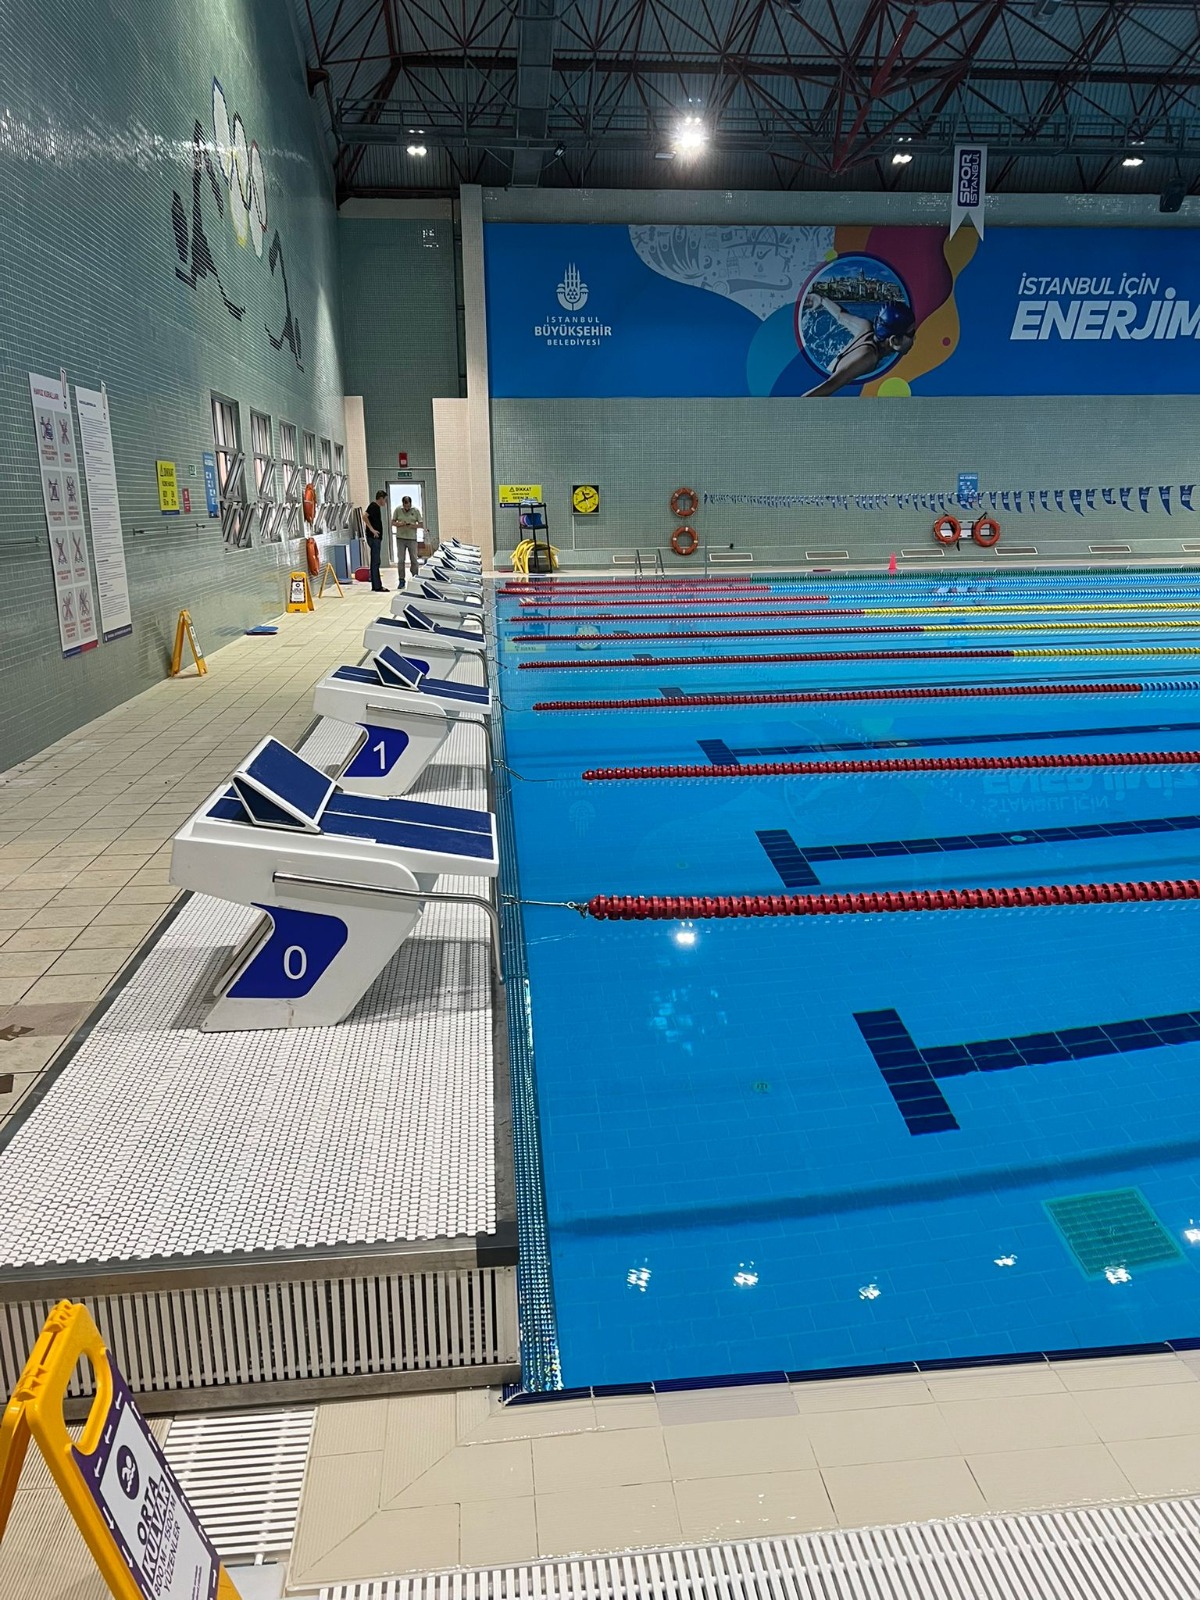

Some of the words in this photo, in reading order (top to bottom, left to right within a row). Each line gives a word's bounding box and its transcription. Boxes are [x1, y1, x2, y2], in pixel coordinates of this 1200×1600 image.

[960, 153, 972, 204] SPOR
[1018, 272, 1114, 295] İSTANBUL
[1118, 272, 1160, 298] İÇİN
[534, 324, 612, 337] BÜYÜKŞEHİR
[1010, 287, 1200, 340] ENERJİM
[373, 741, 386, 770] 1
[284, 946, 306, 980] 0
[138, 1476, 160, 1546] ORTA
[142, 1474, 170, 1586] KULVAR
[154, 1566, 164, 1596] 800
[160, 1550, 168, 1562] M
[164, 1510, 174, 1542] 1500
[170, 1495, 177, 1508] M
[164, 1521, 180, 1592] YÜZENLER
